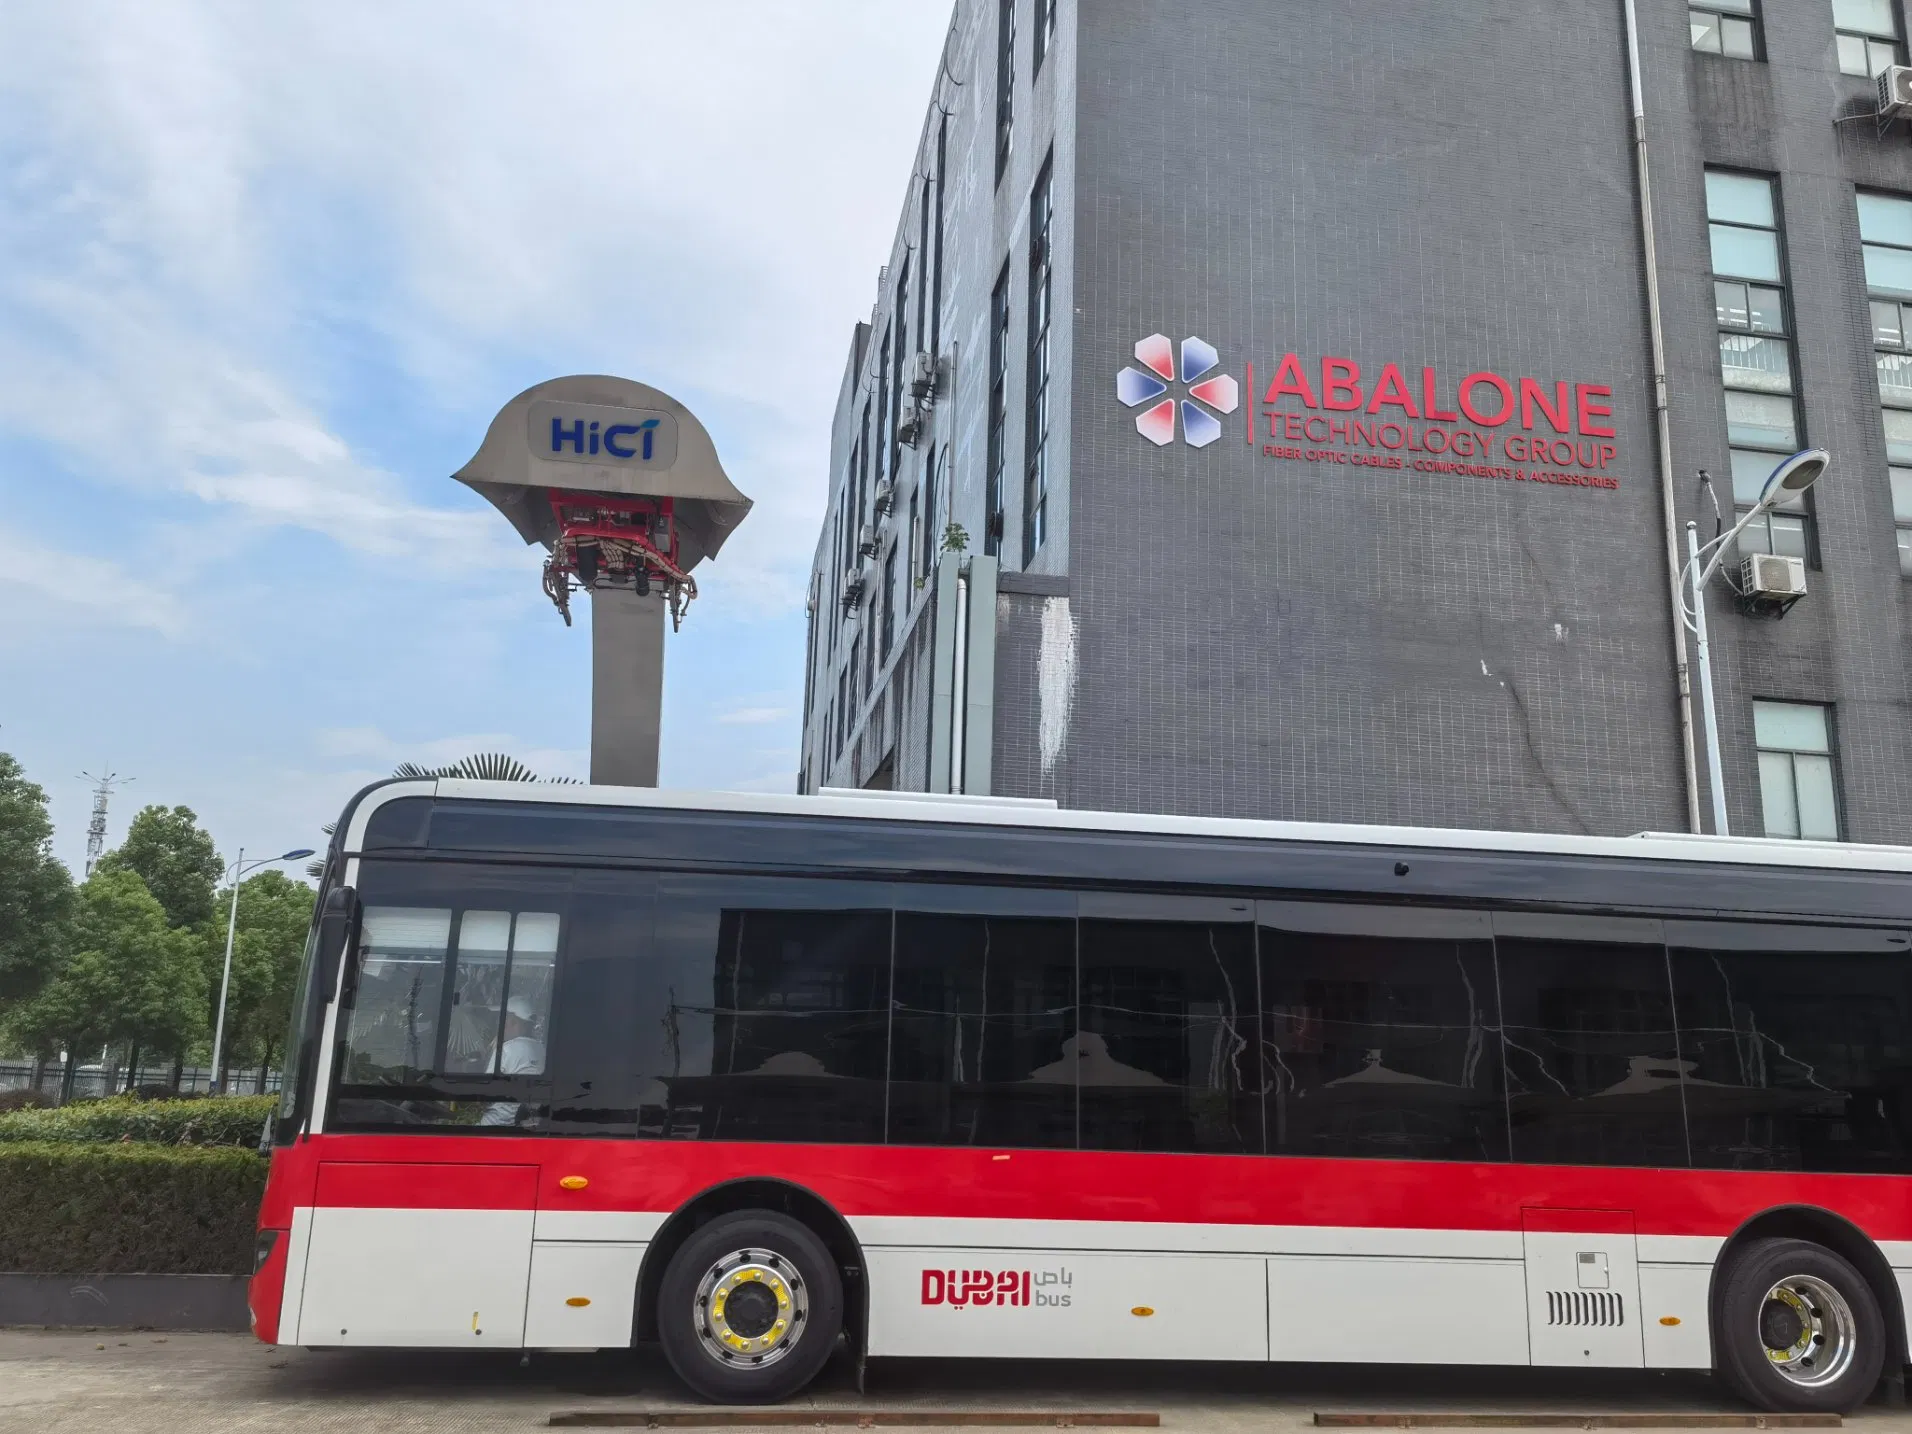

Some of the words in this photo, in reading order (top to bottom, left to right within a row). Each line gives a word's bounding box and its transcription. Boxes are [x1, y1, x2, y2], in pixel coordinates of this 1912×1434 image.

[1263, 352, 1616, 437] ABALONE
[1263, 411, 1495, 457] TECHNOLOGY
[1504, 435, 1617, 469] GROUP
[1263, 444, 1302, 459] FIBER
[1305, 450, 1349, 465] OPTIC
[1350, 453, 1403, 469] CABLES
[1414, 460, 1512, 480] COMPONENTS
[1515, 469, 1526, 480] &
[1529, 470, 1619, 489] ACCESSORIES
[921, 1269, 1031, 1310] DUBAI
[1034, 1267, 1073, 1289] باص
[1035, 1290, 1072, 1307] bus
